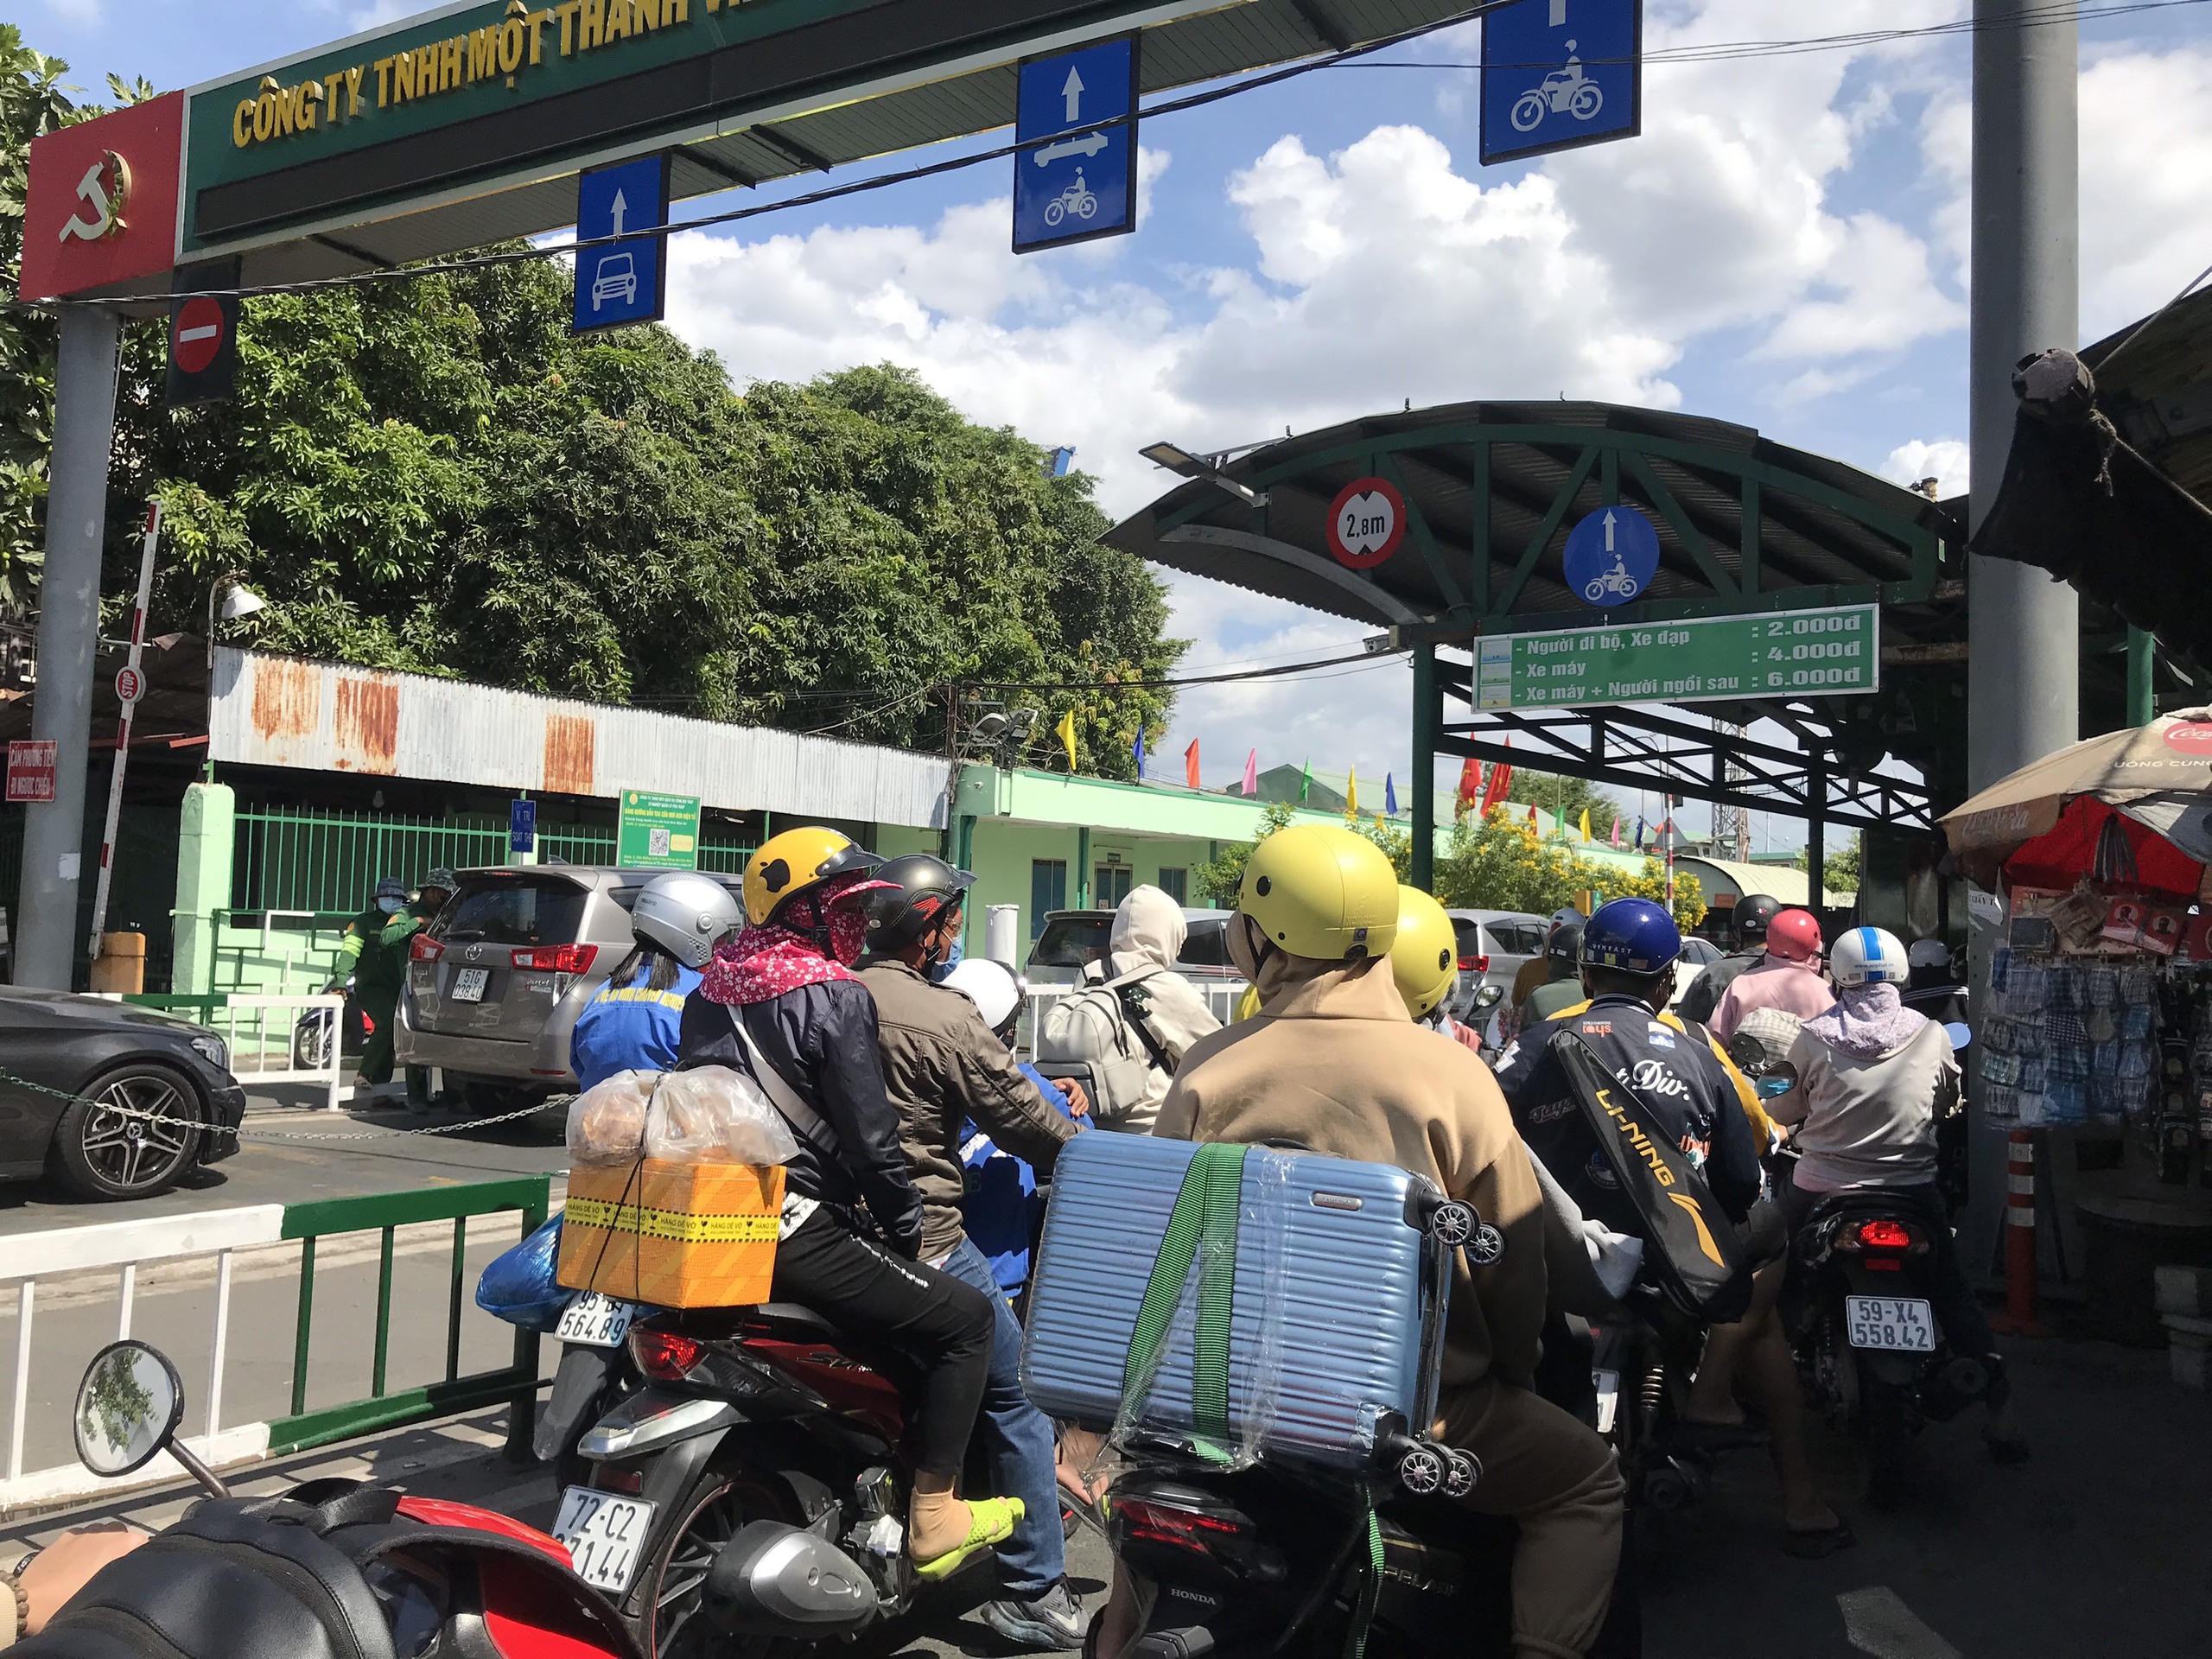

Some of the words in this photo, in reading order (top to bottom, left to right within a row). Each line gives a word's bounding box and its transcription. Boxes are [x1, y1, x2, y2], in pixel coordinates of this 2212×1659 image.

[232, 75, 321, 149] CÔNG
[324, 65, 365, 123] TY
[373, 35, 465, 108] TNHH
[467, 0, 550, 88] MỘT
[1346, 513, 1385, 538] 2,8m
[1527, 638, 1574, 656] Người
[1580, 635, 1595, 651] đi
[1630, 631, 1652, 646] Xe
[1657, 629, 1690, 647] đạp
[1767, 614, 1861, 637] 2.000đ
[1526, 664, 1547, 678] Xe
[1551, 660, 1586, 677] máy
[1767, 640, 1861, 662] 4.000đ
[121, 671, 135, 697] STOP
[1526, 686, 1547, 701] Xe
[1551, 683, 1586, 700] máy
[1608, 679, 1657, 697] Người
[1662, 674, 1702, 694] ngồi
[1707, 677, 1739, 690] sau
[1767, 666, 1861, 687] 6.000đ
[464, 969, 481, 983] 51G
[454, 983, 483, 1000] 038.40
[1595, 1088, 1675, 1187] LI-NING
[1858, 1300, 1919, 1324] 59-X4
[560, 1313, 626, 1342] 564.89
[1854, 1323, 1929, 1348] 558.42
[568, 1494, 636, 1541] 72-C2
[1171, 1588, 1217, 1605] HONDA
